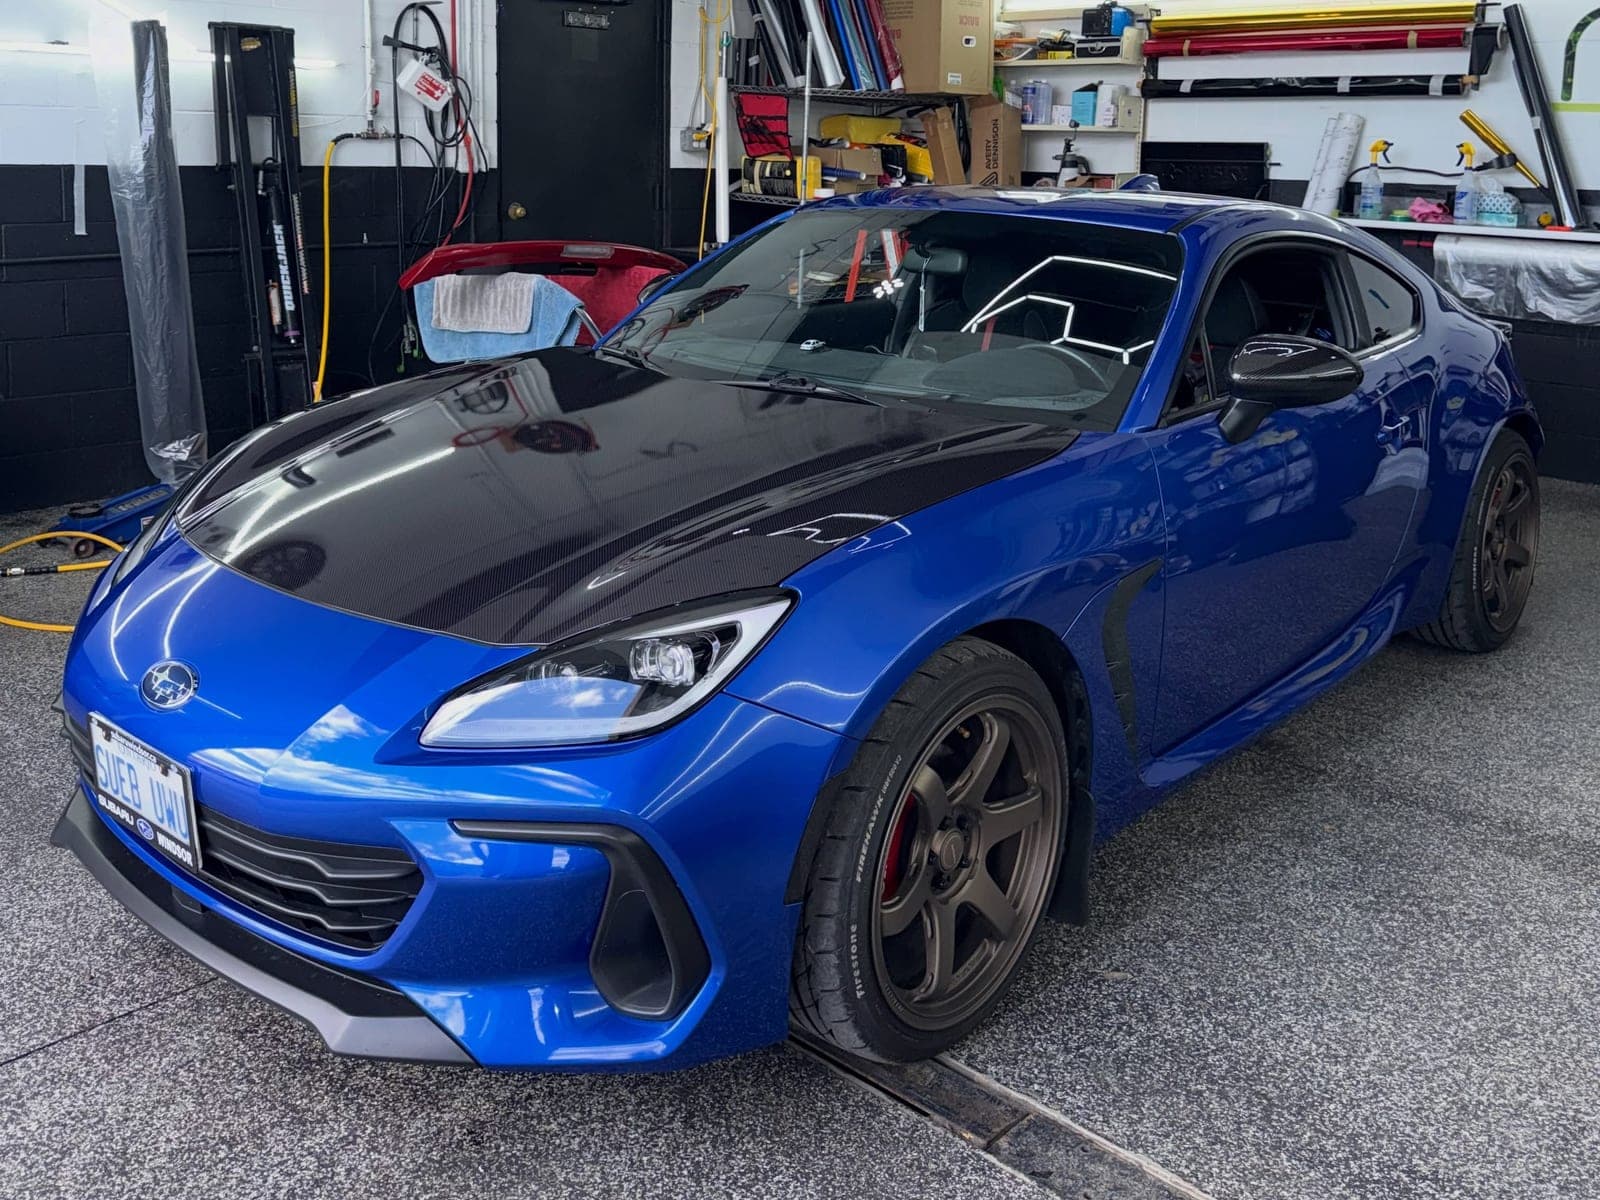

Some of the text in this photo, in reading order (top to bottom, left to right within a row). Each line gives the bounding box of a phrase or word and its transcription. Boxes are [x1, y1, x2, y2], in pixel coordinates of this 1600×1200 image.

[273, 223, 296, 311] QUICKJACK
[94, 743, 142, 810] SUEB
[149, 776, 189, 840] UWU
[97, 794, 194, 867] SUBARU WINDSOR
[855, 794, 883, 883] FIREHAWK
[850, 923, 866, 999] Firestone
